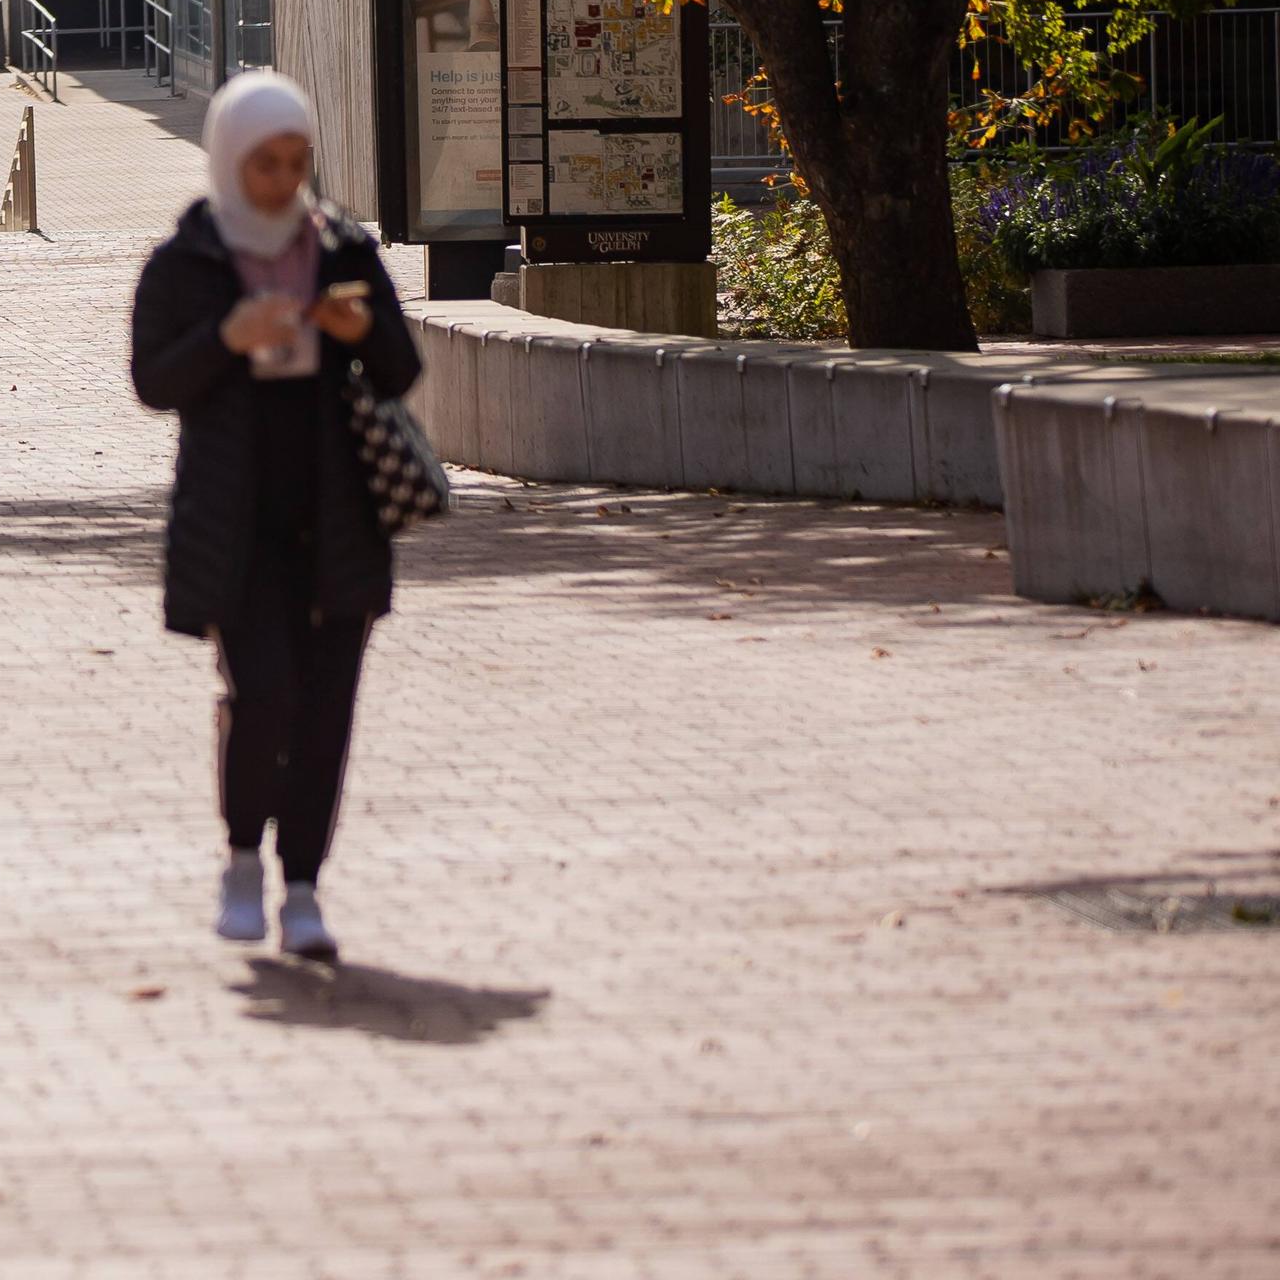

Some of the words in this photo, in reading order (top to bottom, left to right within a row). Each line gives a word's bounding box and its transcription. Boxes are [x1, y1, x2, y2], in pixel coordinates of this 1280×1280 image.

[431, 70, 463, 85] Help
[466, 70, 478, 82] is
[480, 70, 501, 84] jus
[431, 97, 466, 105] anything
[479, 97, 497, 105] your
[588, 231, 650, 245] UNIVERSITY
[599, 241, 641, 253] GUELPH
